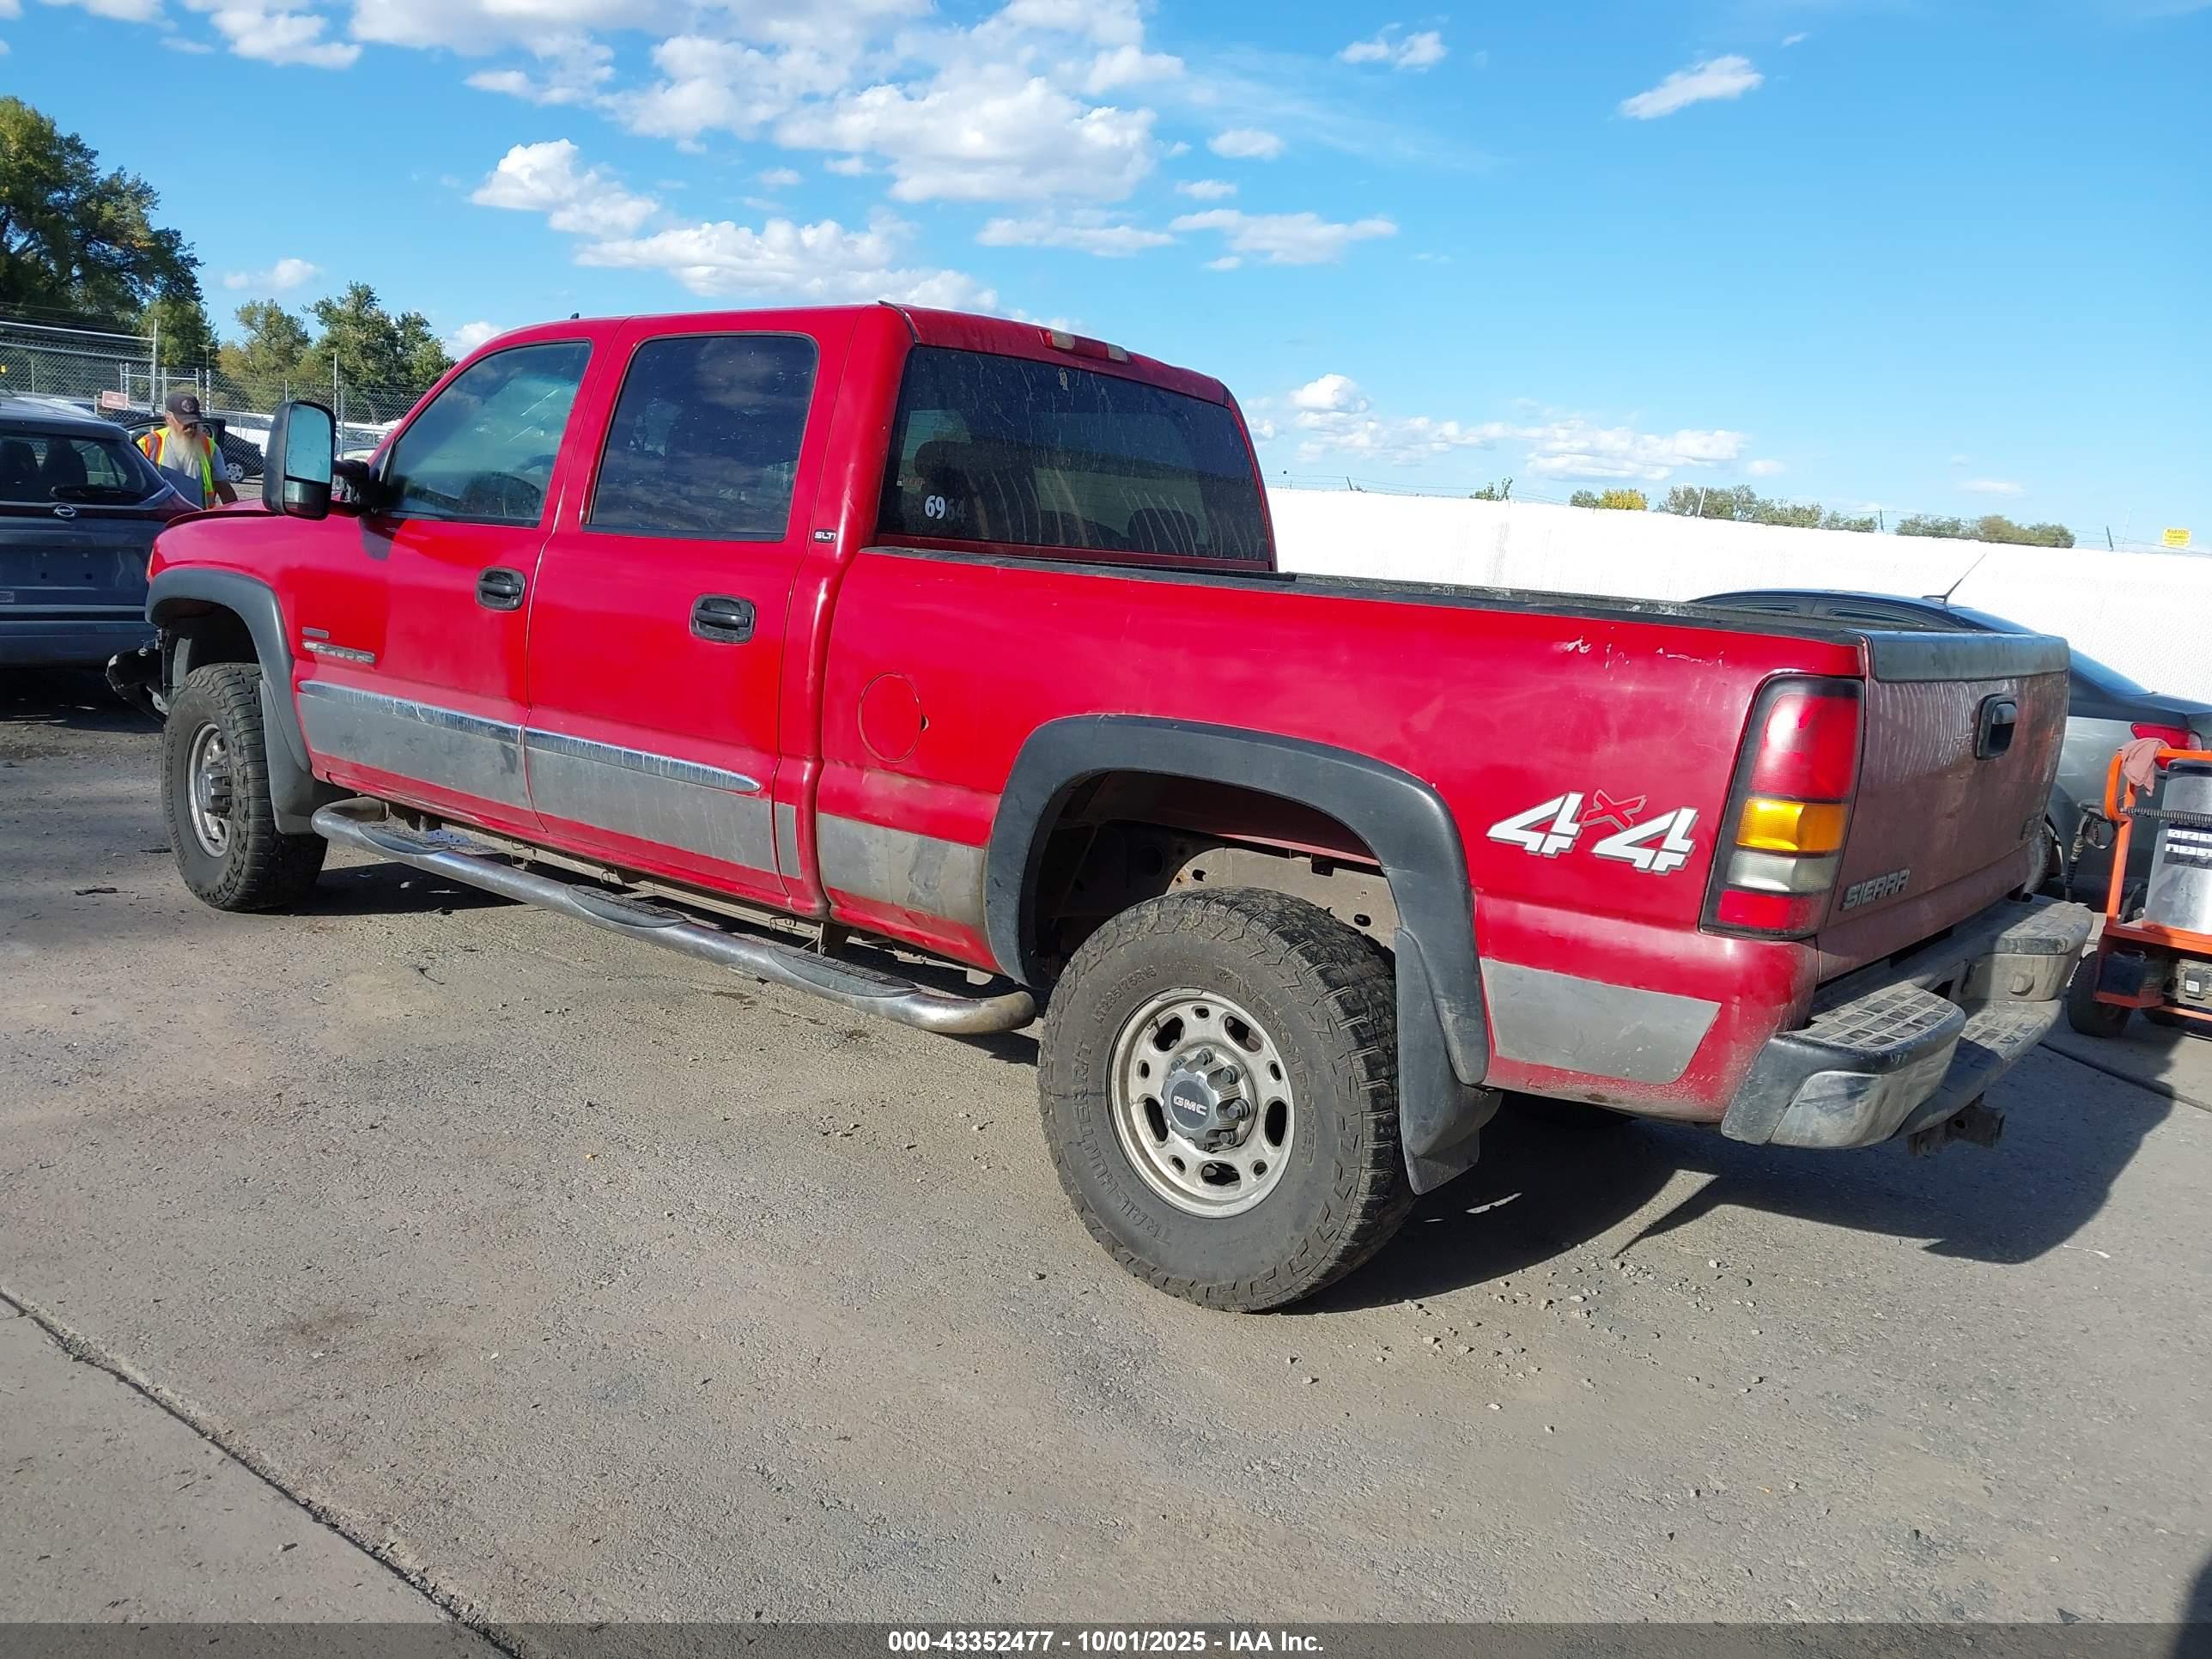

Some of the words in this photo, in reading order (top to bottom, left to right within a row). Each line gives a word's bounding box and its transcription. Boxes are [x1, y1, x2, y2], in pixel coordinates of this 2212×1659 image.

[1843, 867, 1911, 911] SIERRA
[1173, 1095, 1207, 1116] GMC
[1074, 1088, 1120, 1195] HUNTER
[1118, 1190, 1170, 1246] TRAIL
